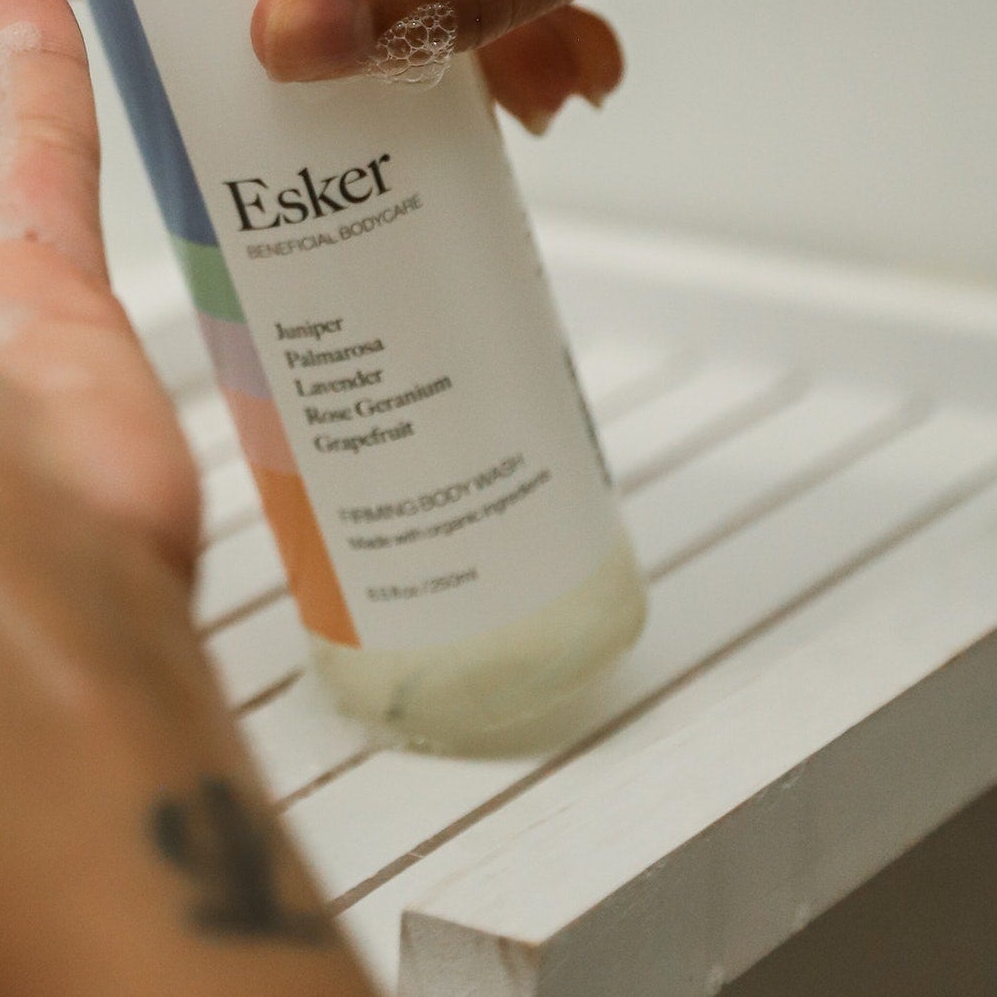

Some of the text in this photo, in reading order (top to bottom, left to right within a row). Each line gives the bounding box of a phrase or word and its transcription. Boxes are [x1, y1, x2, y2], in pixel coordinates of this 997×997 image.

[223, 154, 391, 231] Esker
[247, 194, 423, 259] BENEFICIAL BODYCARE
[275, 318, 343, 340] Juniper
[285, 339, 384, 369] Palmarosa
[295, 369, 383, 397] Lavender
[305, 376, 452, 425] Rose Geranium
[314, 422, 413, 454] Grapefruit
[419, 482, 470, 512] BODY
[473, 453, 525, 490] WASH
